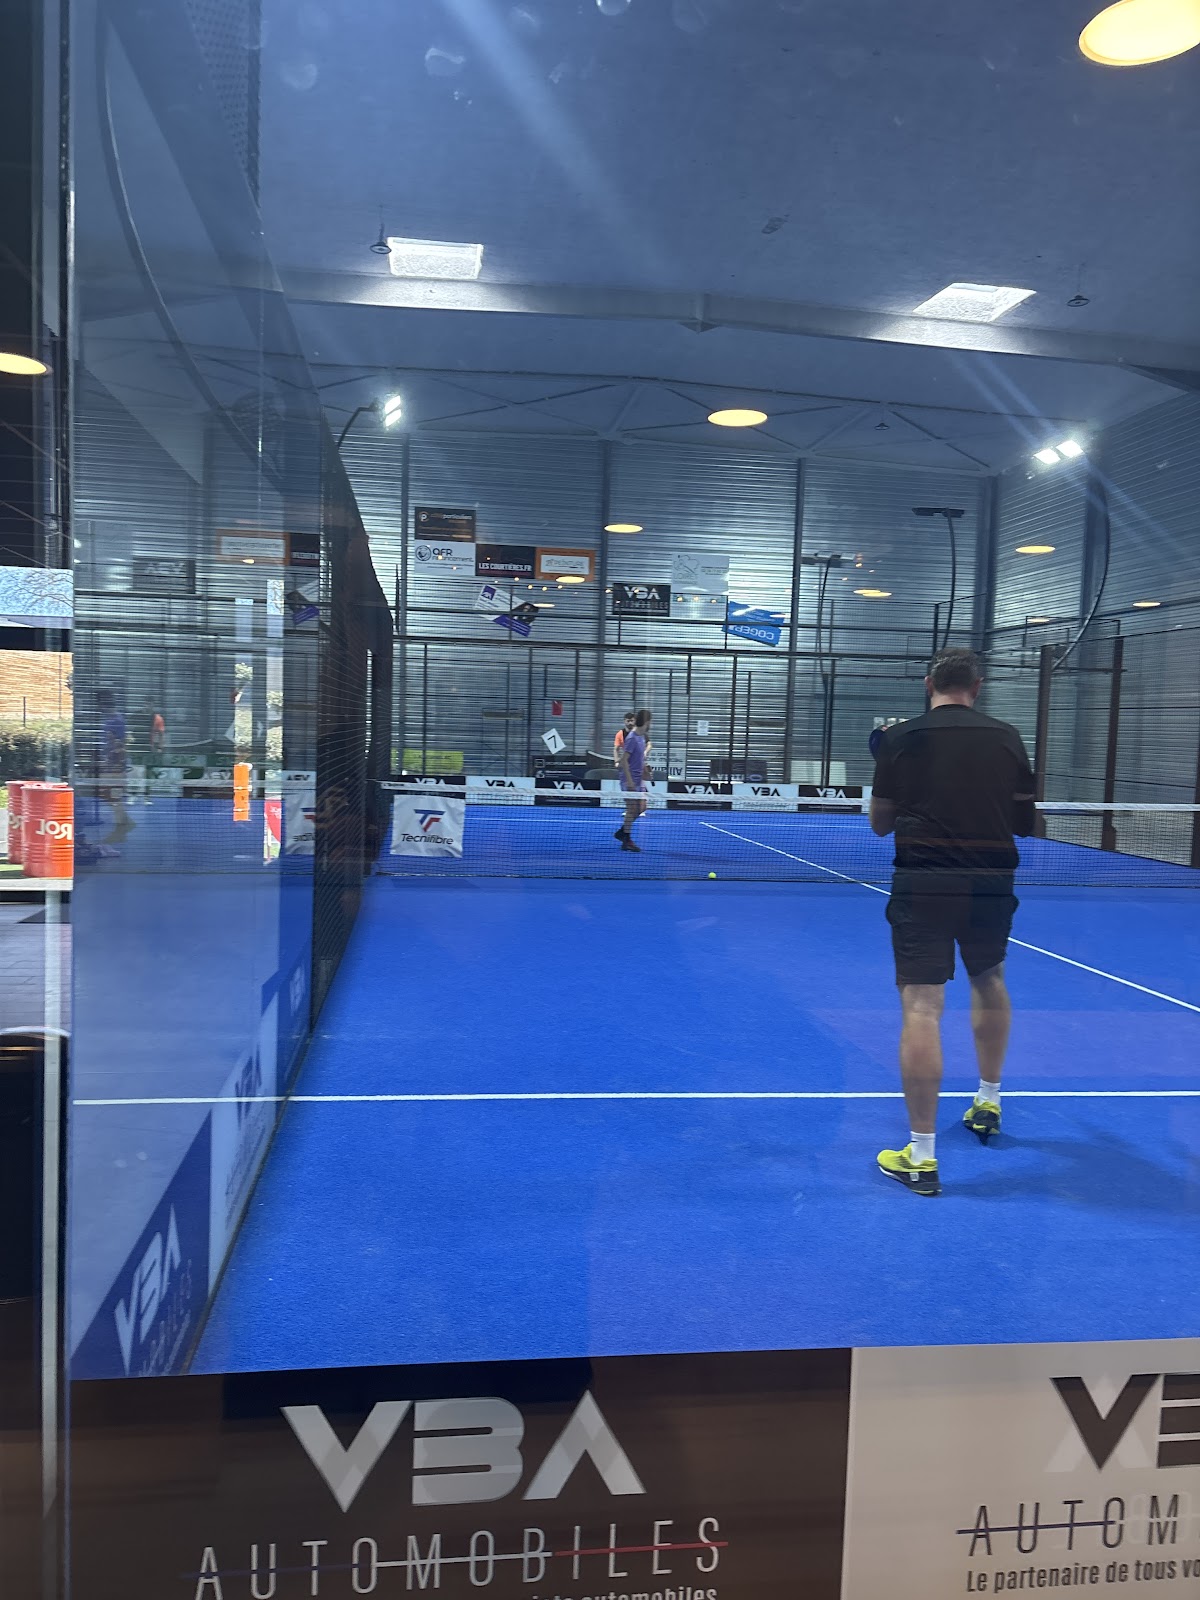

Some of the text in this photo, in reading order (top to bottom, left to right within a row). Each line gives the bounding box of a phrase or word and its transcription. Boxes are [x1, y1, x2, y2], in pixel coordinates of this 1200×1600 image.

[623, 586, 660, 600] VBA
[547, 735, 558, 749] 7
[553, 781, 584, 790] VBA
[685, 785, 715, 795] VBA
[751, 787, 780, 797] VBA
[816, 788, 846, 798] VBA
[401, 833, 454, 845] Tecnifibre
[114, 1203, 181, 1377] VBA
[279, 1389, 647, 1513] VBA
[194, 1517, 721, 1600] AUTOMOBILES
[966, 1569, 988, 1592] Le
[993, 1561, 1100, 1594] partenaire
[1105, 1560, 1129, 1583] de
[1134, 1559, 1178, 1581] tous
